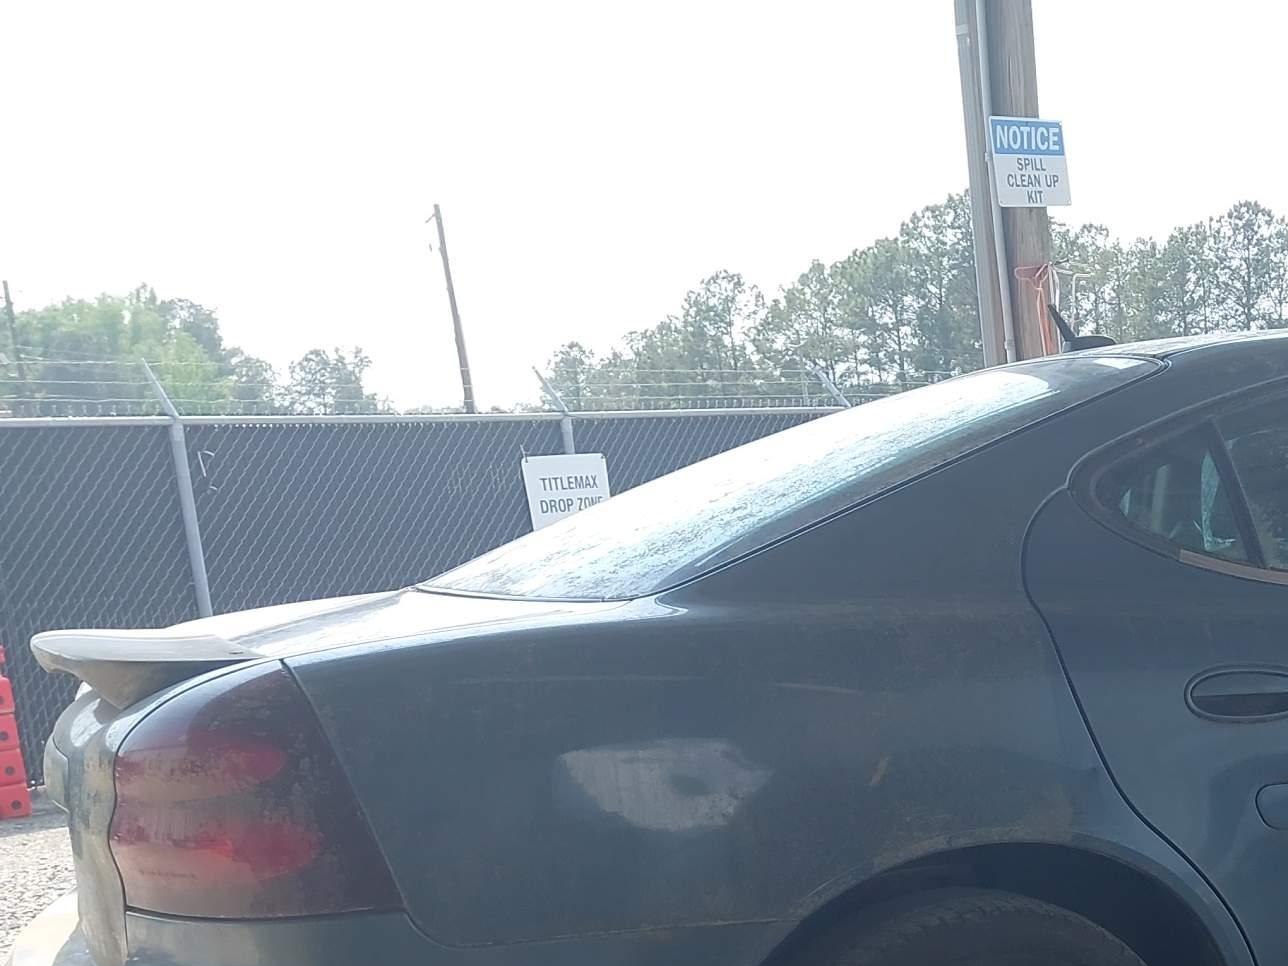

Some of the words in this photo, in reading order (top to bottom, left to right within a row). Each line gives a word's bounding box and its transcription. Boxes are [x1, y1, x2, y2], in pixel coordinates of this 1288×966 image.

[996, 125, 1060, 151] NOTICE
[1016, 157, 1047, 172] SPILL
[1007, 173, 1041, 188] CLEAN
[1044, 174, 1059, 188] UP
[1026, 190, 1044, 204] KIT
[539, 475, 599, 491] TITLEMAX
[540, 498, 574, 514] DROP
